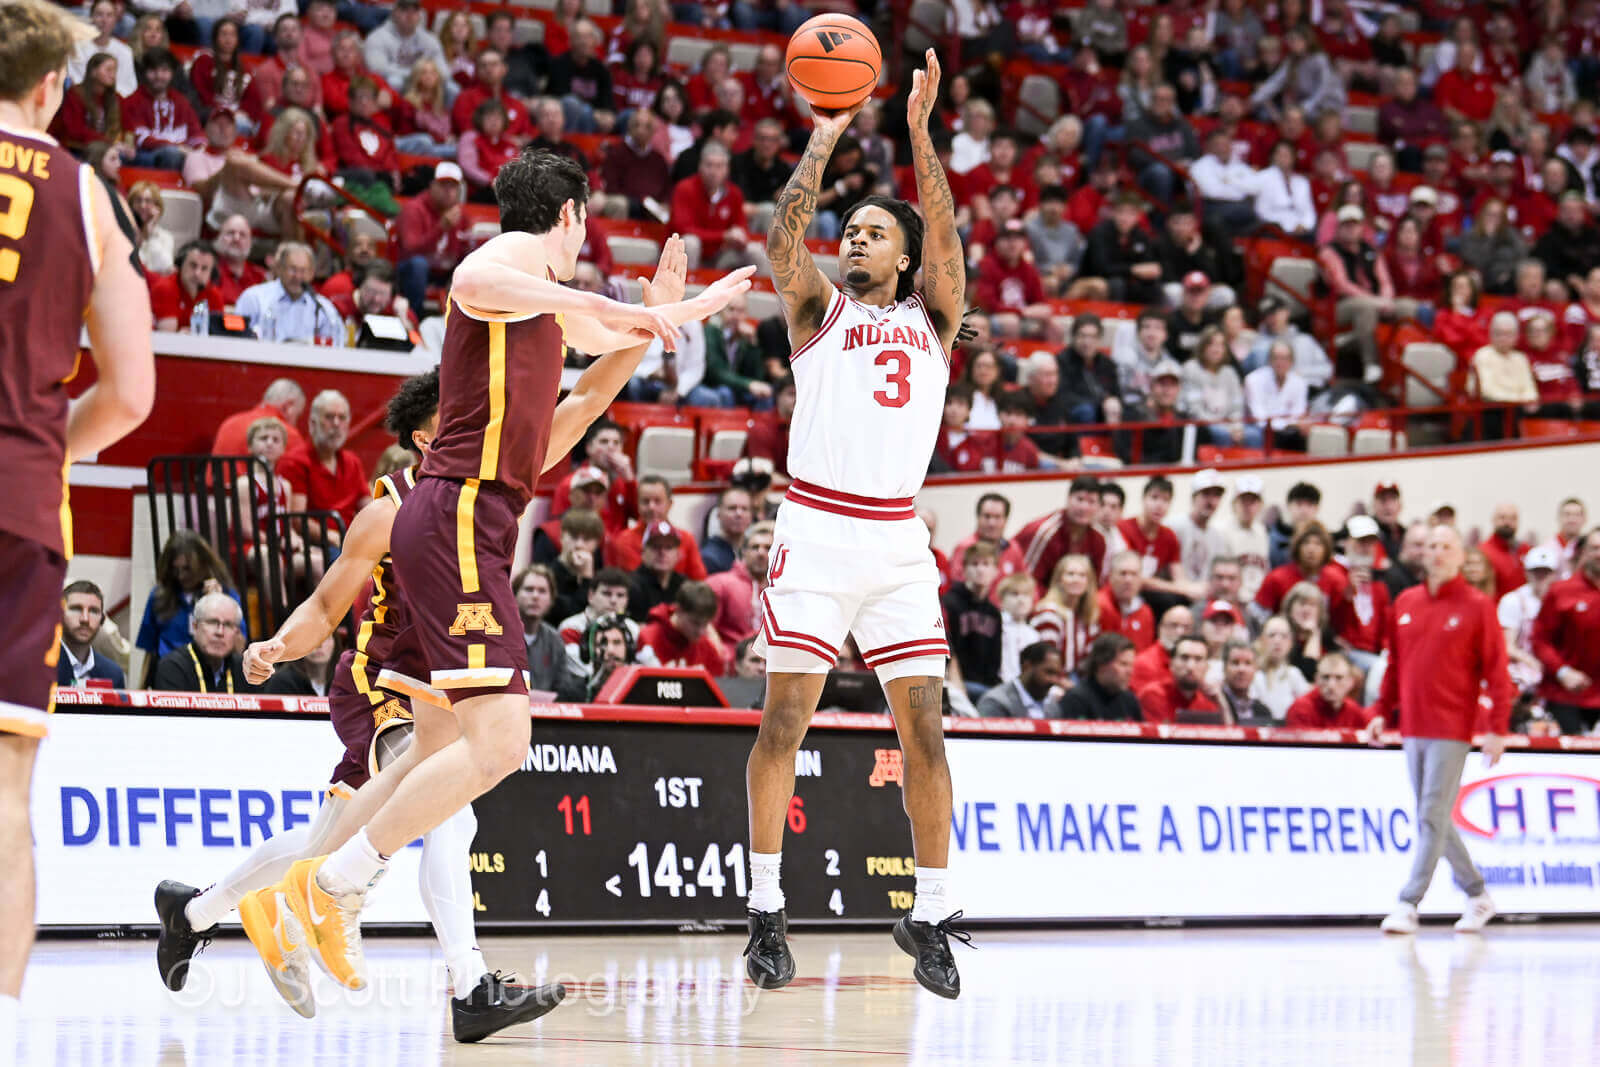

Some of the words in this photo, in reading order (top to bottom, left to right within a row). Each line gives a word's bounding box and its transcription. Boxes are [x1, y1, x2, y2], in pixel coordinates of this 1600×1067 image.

[842, 324, 932, 356] INDIANA
[873, 350, 912, 408] 3
[448, 602, 503, 636] M
[654, 776, 702, 808] 1ST
[60, 786, 423, 848] DIFFERE
[557, 794, 592, 836] 11
[787, 795, 807, 834] 6
[1016, 802, 1141, 852] MAKE
[1158, 804, 1183, 852] A
[1197, 805, 1412, 853] DIFFERENC
[469, 853, 505, 873] ULS
[535, 850, 548, 879] 1
[628, 842, 749, 898] 14:41
[824, 849, 841, 876] 2
[866, 856, 915, 876] FOULS
[535, 888, 551, 917] 4
[828, 888, 845, 916] 4
